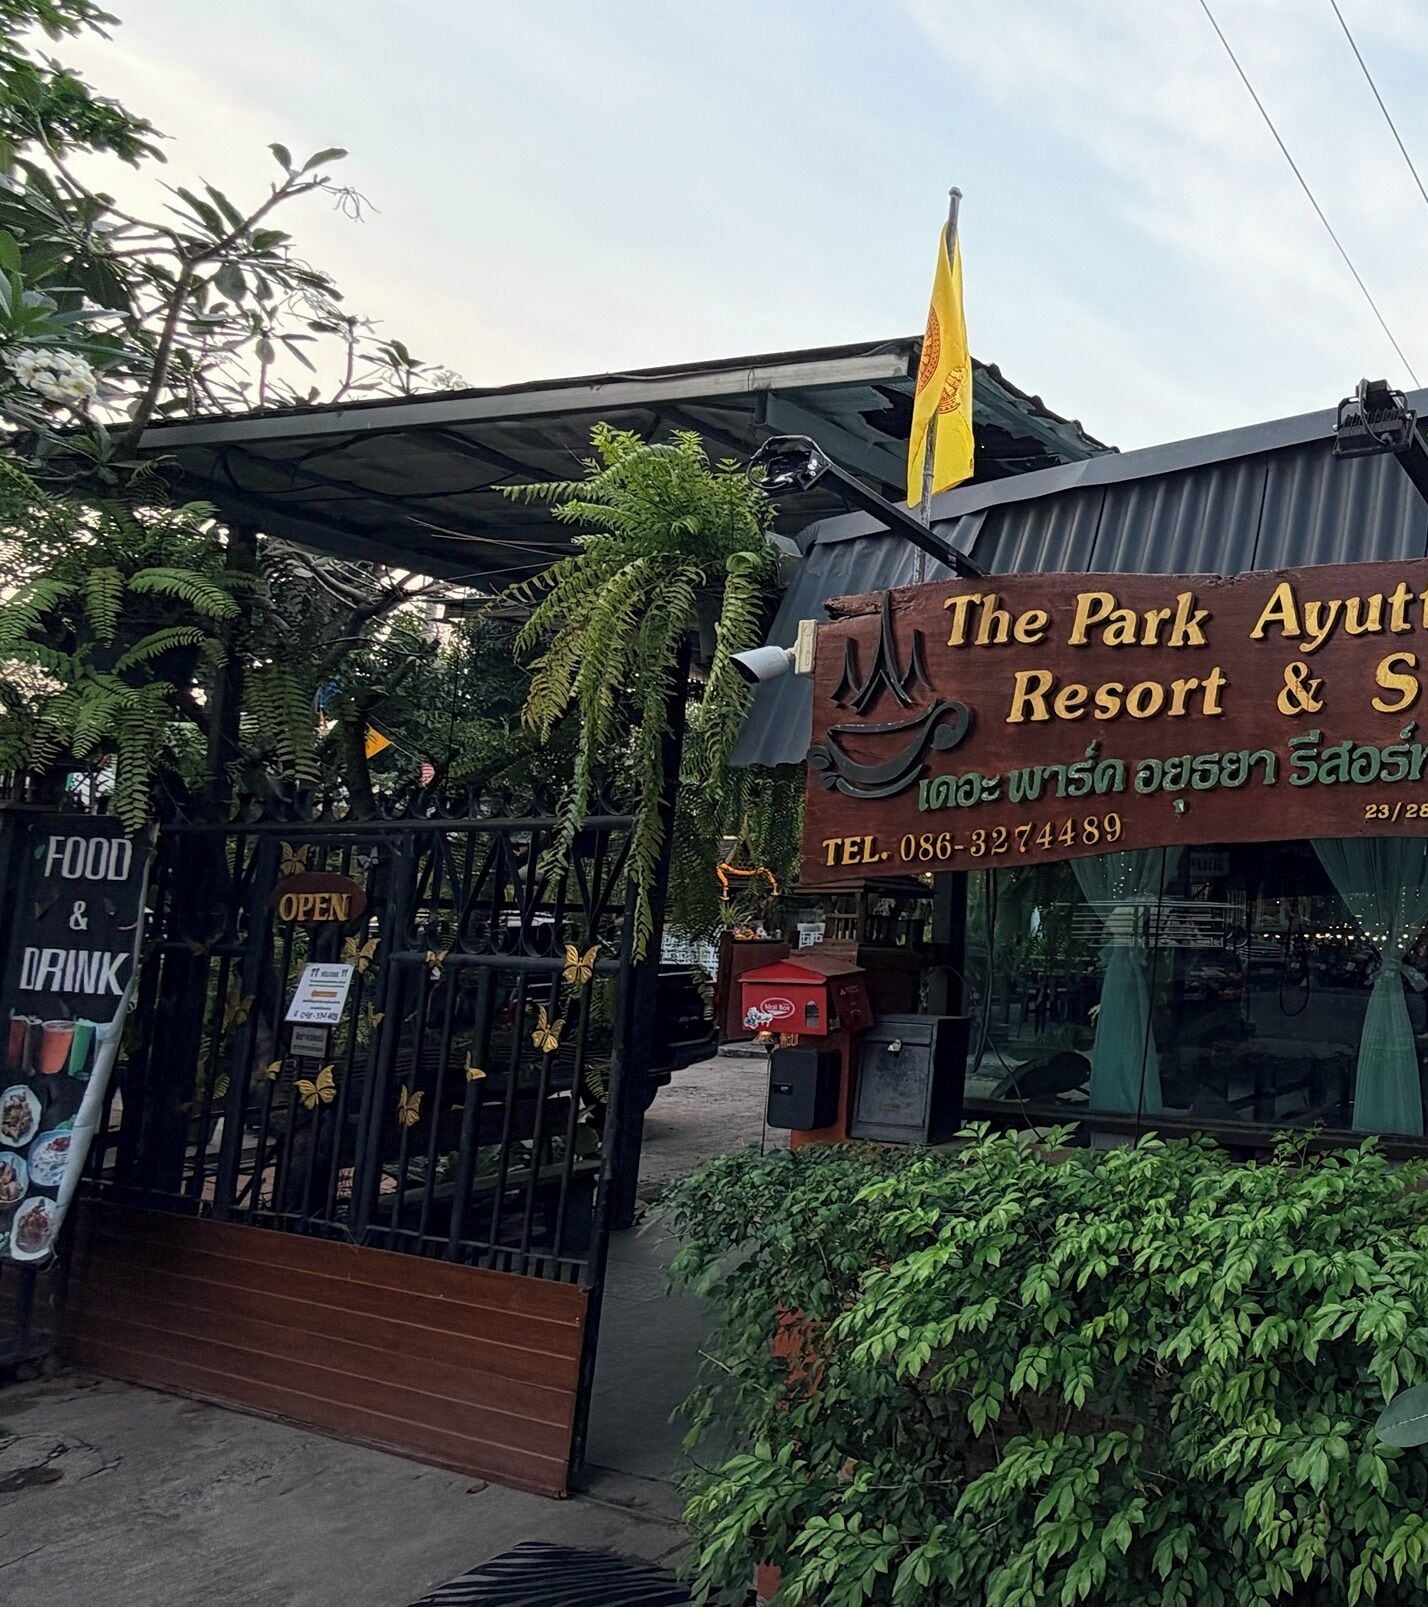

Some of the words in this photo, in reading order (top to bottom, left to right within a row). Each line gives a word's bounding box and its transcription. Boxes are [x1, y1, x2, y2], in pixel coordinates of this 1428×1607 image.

[943, 591, 1049, 647] The
[1067, 590, 1212, 648] Park
[1005, 666, 1227, 723] Resort
[1276, 660, 1324, 716] &
[917, 771, 1000, 812] เดอะ
[1007, 738, 1127, 804] พาร์ค
[1134, 748, 1277, 814] อยุธยา
[44, 835, 133, 881] FOOD
[822, 835, 888, 867] TEL.
[900, 812, 1122, 862] 086-3274489
[69, 900, 89, 931] &
[279, 893, 352, 922] OPEN
[19, 947, 131, 996] DRINK
